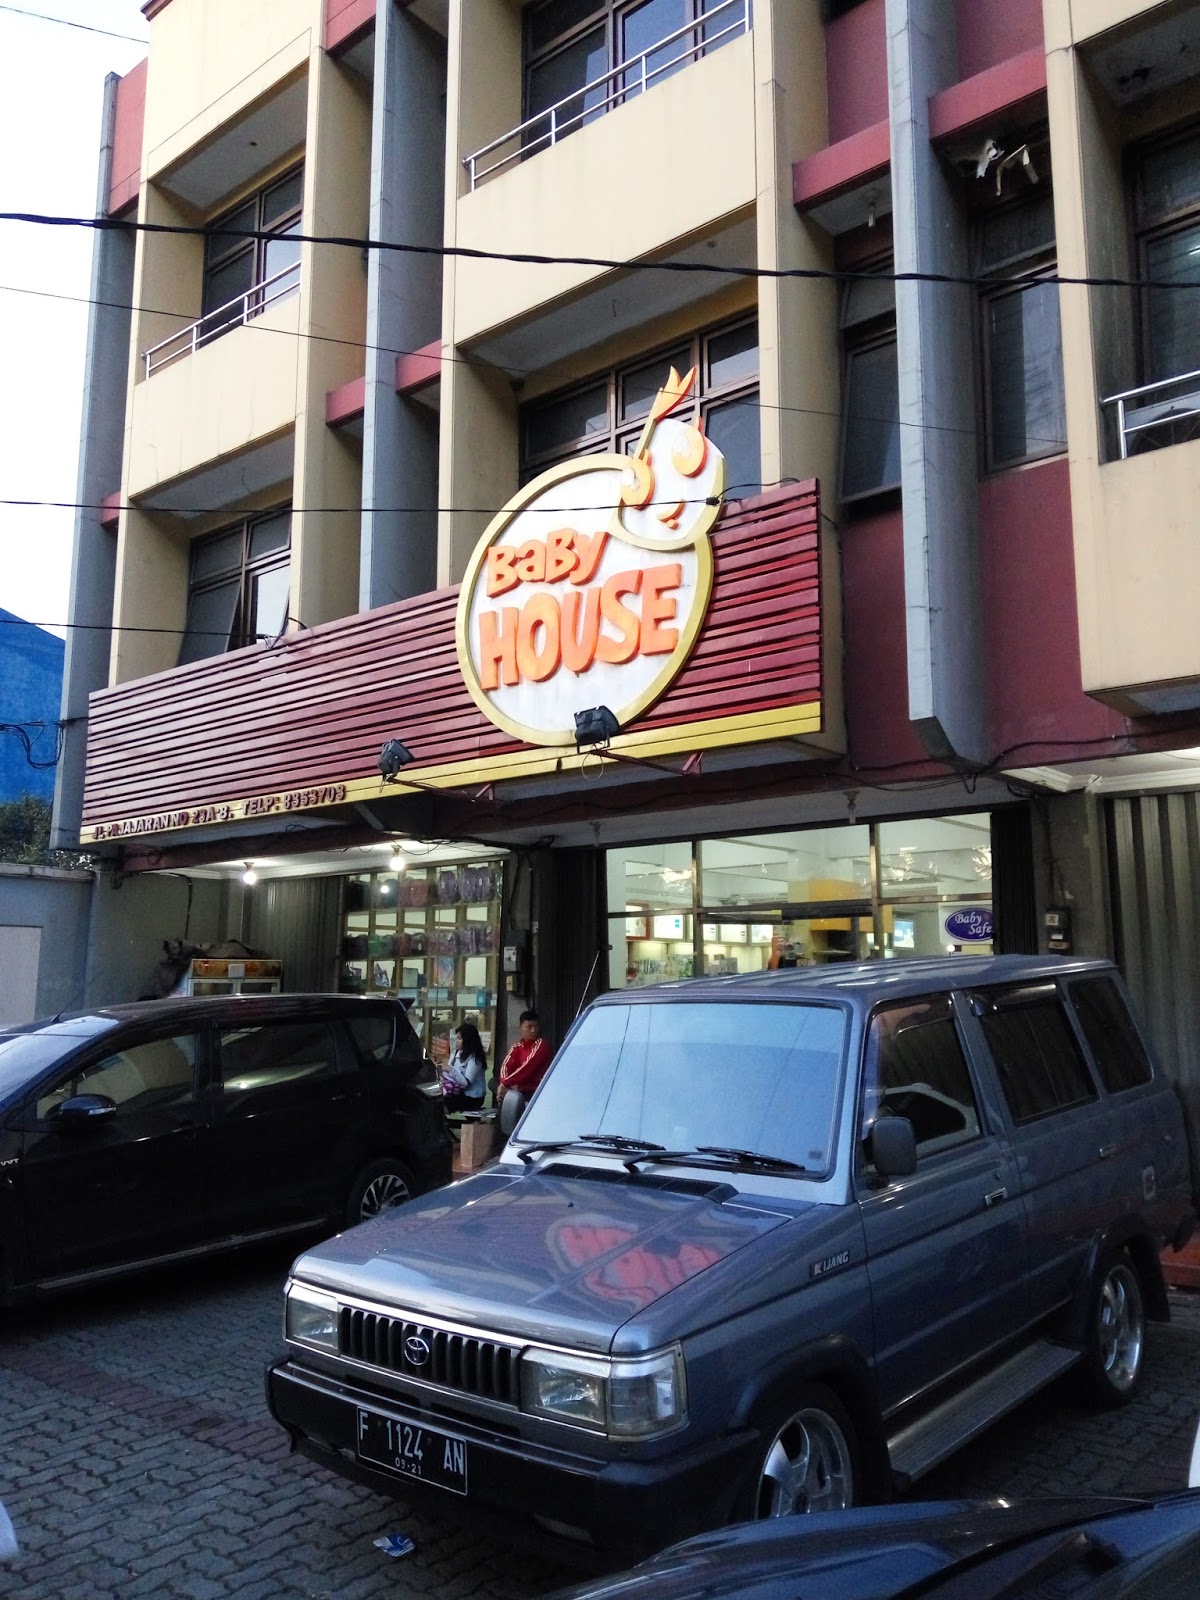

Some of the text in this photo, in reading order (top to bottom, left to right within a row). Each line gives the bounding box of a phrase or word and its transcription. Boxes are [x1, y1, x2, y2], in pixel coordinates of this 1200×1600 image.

[479, 564, 682, 691] HOUSE
[106, 814, 171, 838] PAJAJARAN
[284, 784, 346, 810] 8353703
[955, 912, 982, 926] Baby
[968, 922, 993, 937] Safe
[360, 1411, 464, 1476] F 1124 AN
